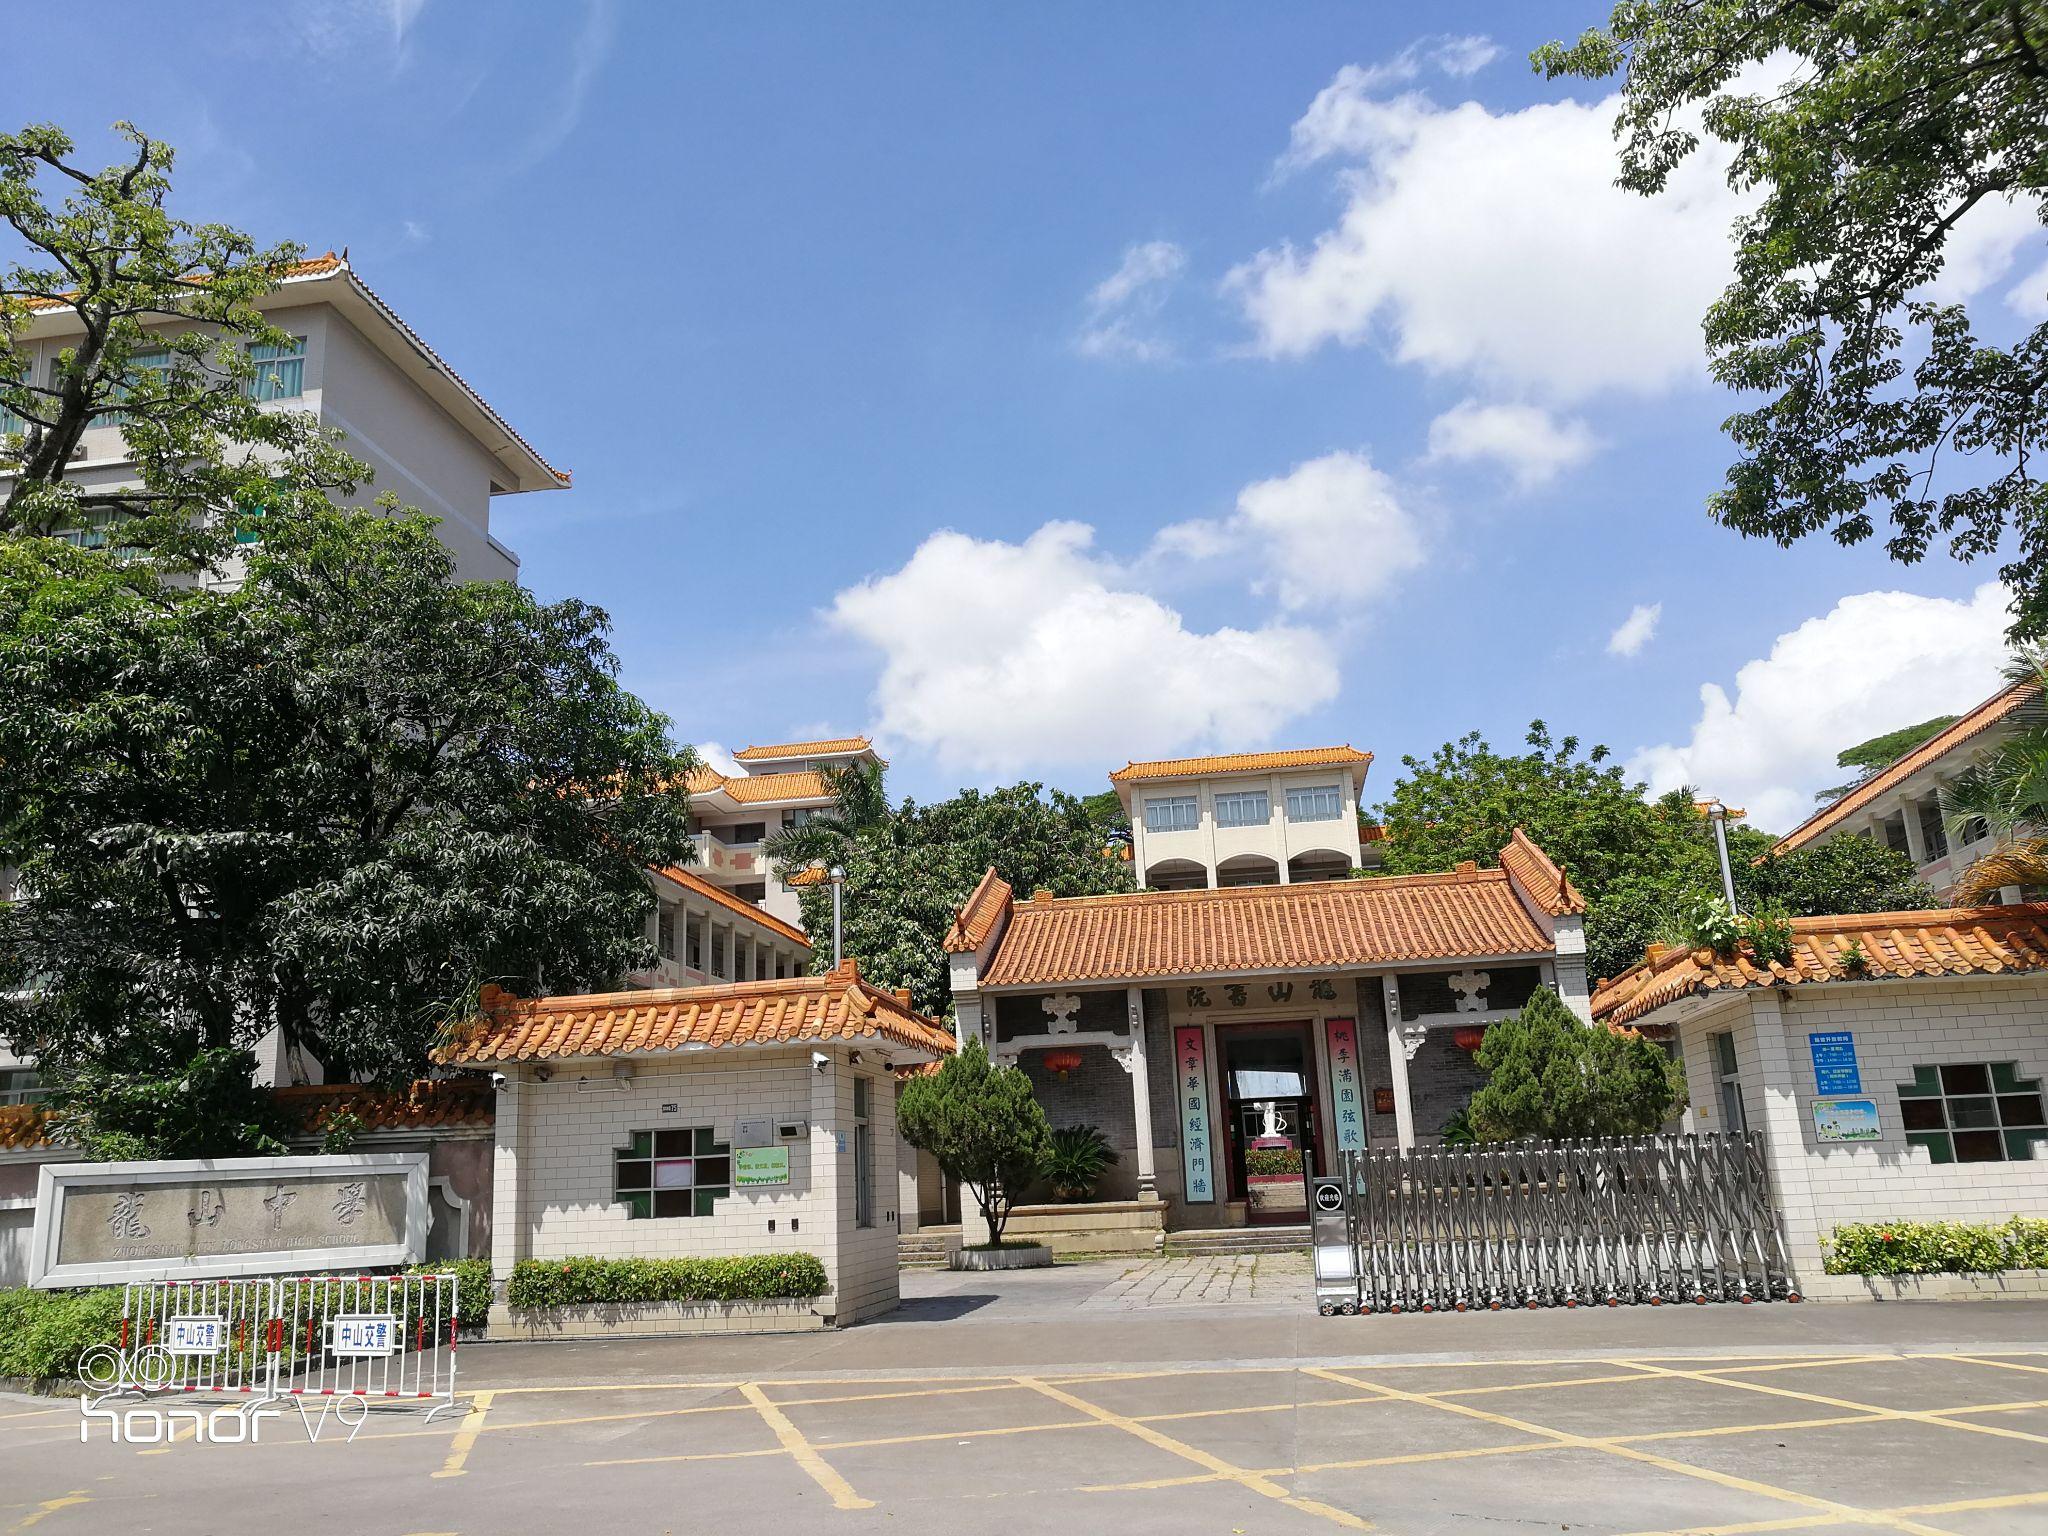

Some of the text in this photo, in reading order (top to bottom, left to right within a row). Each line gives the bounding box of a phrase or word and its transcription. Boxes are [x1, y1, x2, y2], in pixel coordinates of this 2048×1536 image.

[176, 1323, 215, 1347] 中山交警
[342, 1322, 387, 1349] 中山交警
